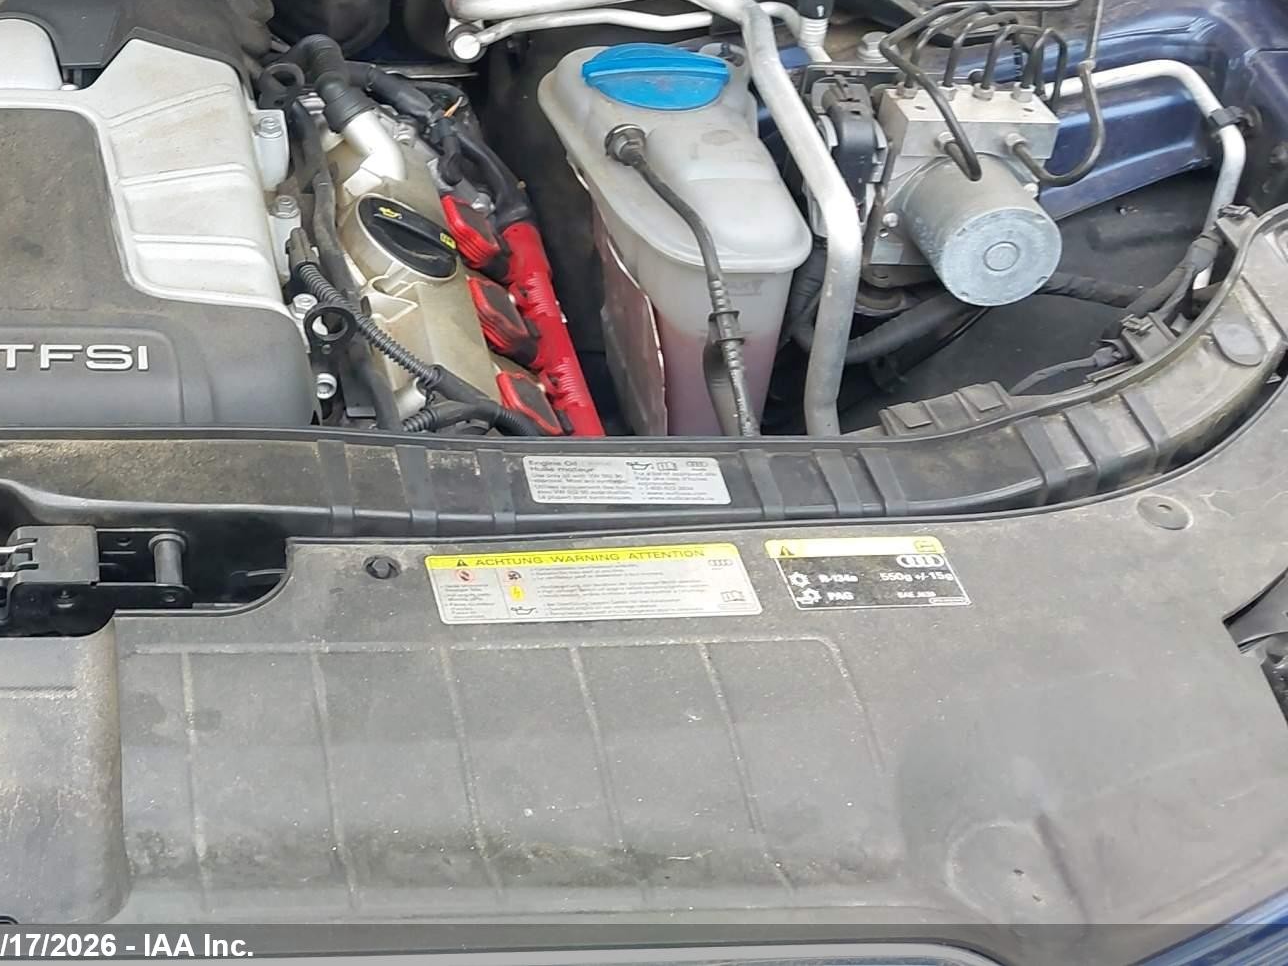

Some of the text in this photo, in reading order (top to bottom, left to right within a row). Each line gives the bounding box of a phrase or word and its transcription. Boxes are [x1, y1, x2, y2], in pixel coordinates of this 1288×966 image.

[474, 549, 706, 567] ACHTUNG WARNING ATTENTION
[880, 572, 914, 583] 550g
